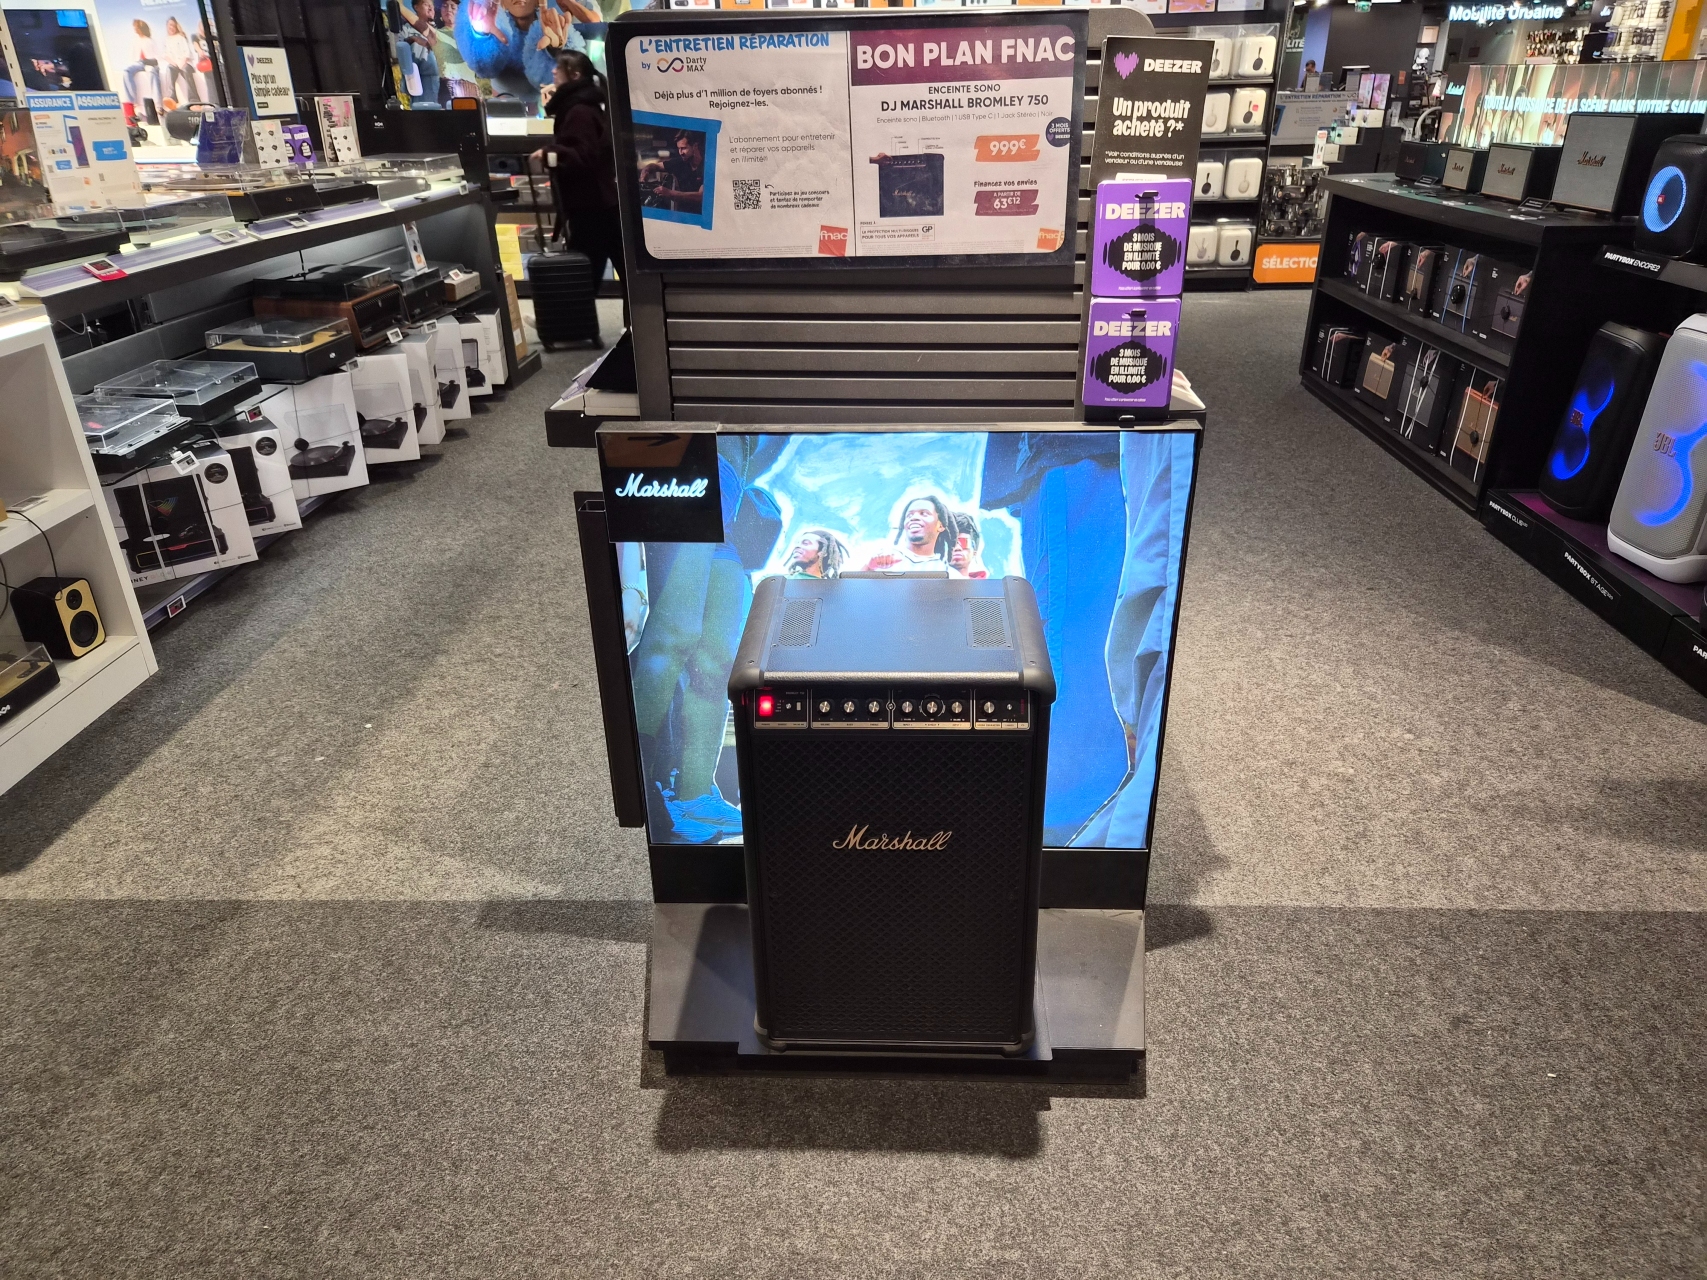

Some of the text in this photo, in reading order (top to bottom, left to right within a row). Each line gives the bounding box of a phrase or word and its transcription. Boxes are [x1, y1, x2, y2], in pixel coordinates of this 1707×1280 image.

[640, 33, 830, 54] L'ENTRETIEN RÉPARATION
[856, 36, 1075, 70] BON PLAN FNAC
[642, 62, 651, 70] by
[686, 56, 707, 65] Darty
[686, 65, 705, 73] MAX
[1144, 59, 1202, 74] DEEZER
[251, 73, 276, 85] Plus qu'un
[254, 86, 271, 98] simple
[654, 90, 674, 100] Déjà
[676, 90, 694, 100] plus
[696, 89, 708, 98] d'1
[710, 88, 738, 98] million
[740, 88, 751, 97] de
[752, 87, 779, 98] foyers
[780, 86, 818, 95] abonnés
[928, 84, 1001, 95] ENCEINTE SONO
[30, 98, 71, 108] ASSURANCE
[77, 96, 120, 106] ASSURANCE
[709, 100, 769, 110] Rejoignez-les.
[881, 95, 1049, 112] DJ MARSHALL BROMLEY 750
[1515, 97, 1555, 112] PUISSANCE
[1555, 98, 1567, 114] DE
[1567, 98, 1579, 114] LA
[1637, 99, 1671, 113] VOTRE
[1113, 97, 1191, 122] Un produit
[972, 113, 987, 121] Type
[1113, 118, 1164, 137] acheté
[729, 136, 780, 144] L'abonnement
[740, 146, 766, 154] réparer
[781, 144, 815, 153] appareils
[990, 139, 1026, 156] 999€
[1151, 152, 1171, 160] auprès
[1105, 202, 1186, 220] DEEZER
[820, 230, 848, 241] fnac
[1133, 233, 1155, 242] 3 MOIS
[1124, 242, 1162, 252] DE MUSIQUE
[1124, 251, 1160, 261] EN ILLIMITÉ
[1605, 252, 1635, 265] PARTYBOX
[1122, 262, 1140, 271] POUR
[1141, 262, 1155, 271] 0,00
[1094, 321, 1172, 336] DEEZER
[1119, 349, 1140, 357] 3 MOIS
[1110, 357, 1148, 366] DE MUSIQUE
[1111, 366, 1145, 375] EN ILLIMITÉ
[1109, 375, 1126, 383] POUR
[1126, 375, 1140, 384] 0,00
[1654, 432, 1677, 458] JBL
[615, 473, 708, 497] Marshall
[1489, 501, 1512, 519] PARTYBOX
[1564, 552, 1591, 580] PARTYBOX
[833, 824, 953, 851] Marshall
